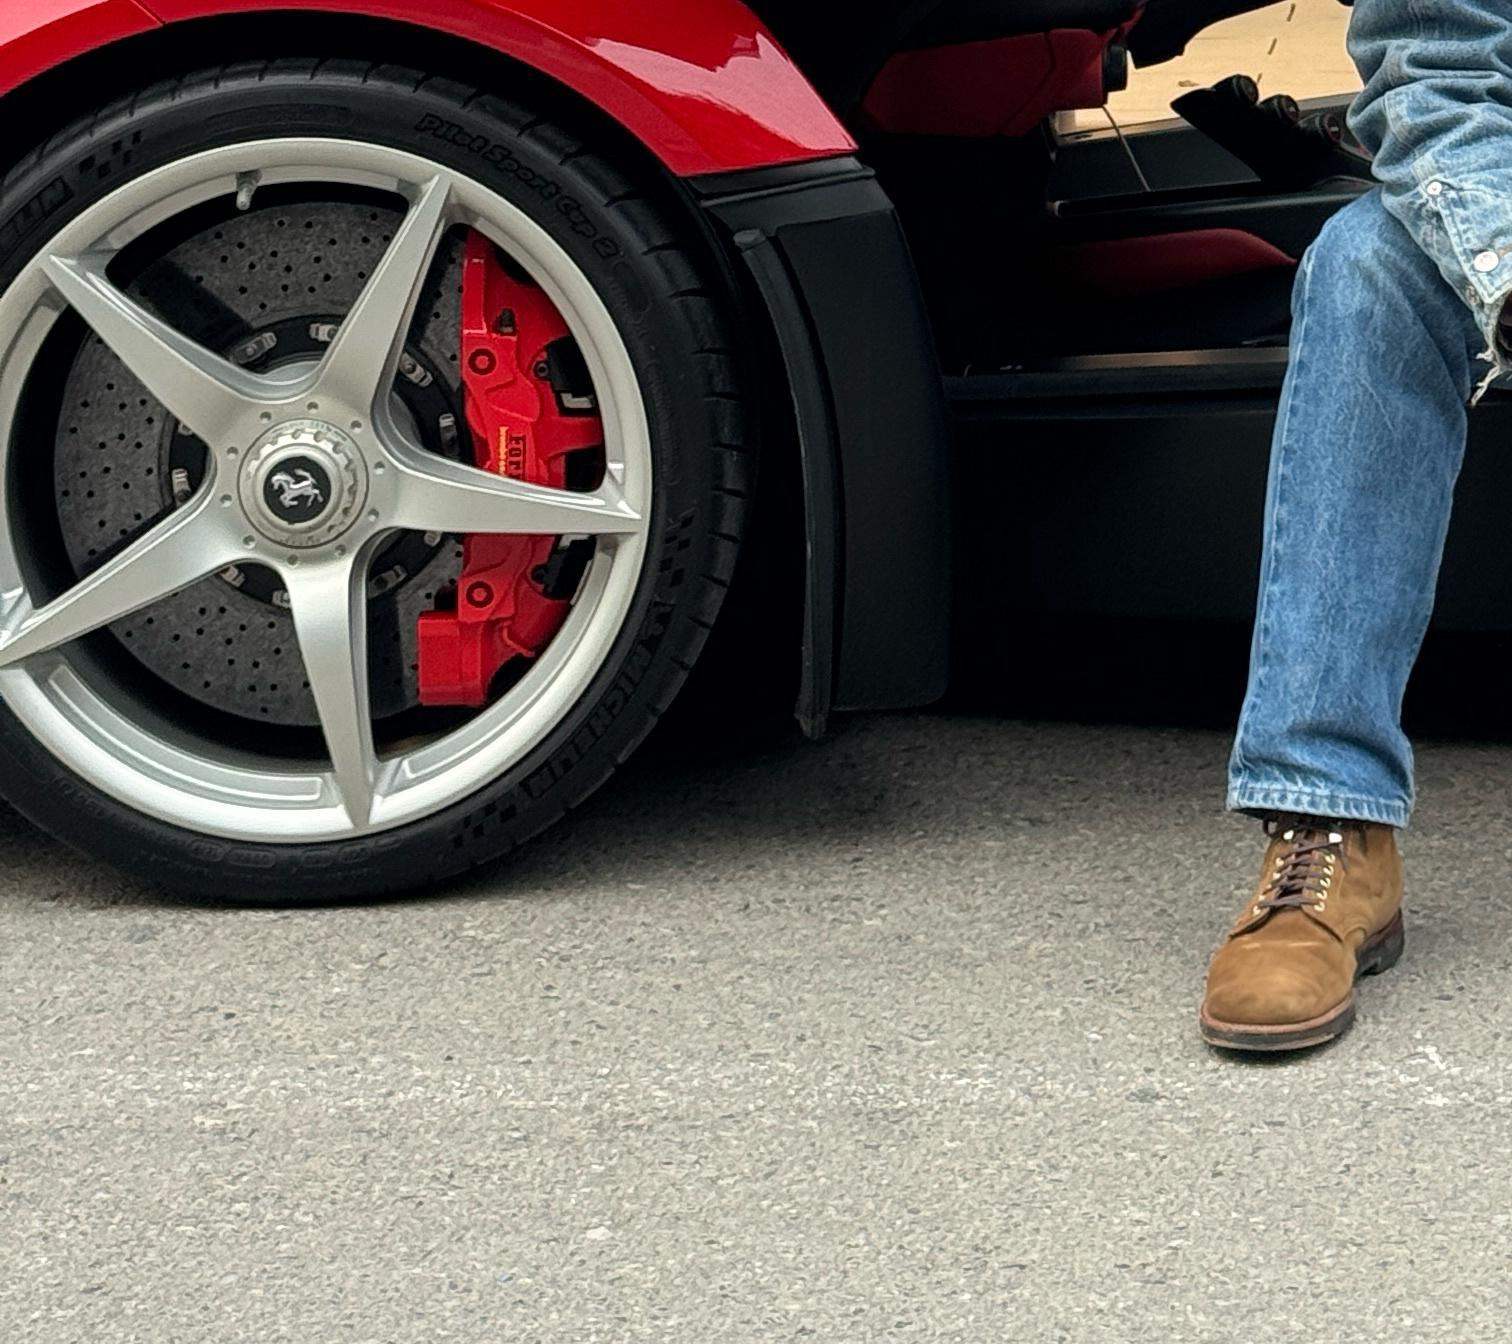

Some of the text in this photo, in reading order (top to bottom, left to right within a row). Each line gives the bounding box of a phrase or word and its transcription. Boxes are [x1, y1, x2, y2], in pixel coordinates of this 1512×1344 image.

[416, 114, 618, 258] Pilot Sport Cup 2
